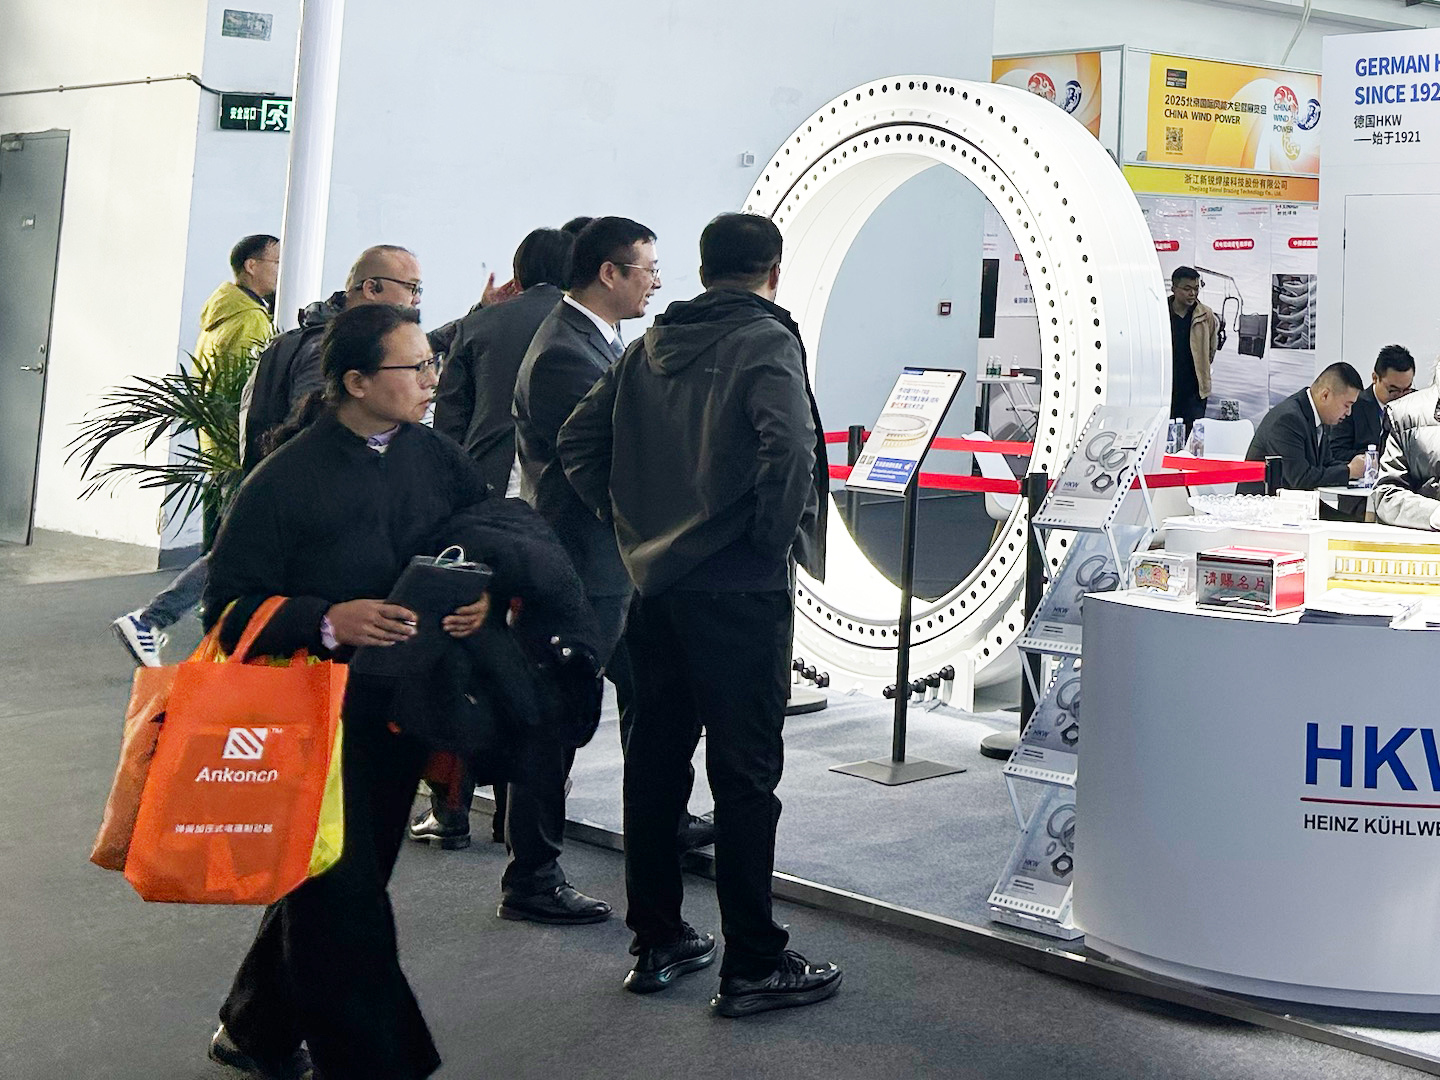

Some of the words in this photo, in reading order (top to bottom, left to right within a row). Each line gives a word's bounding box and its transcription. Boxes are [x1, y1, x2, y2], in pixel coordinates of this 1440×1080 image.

[1355, 54, 1430, 77] GERMAN
[1354, 84, 1406, 106] SINCE
[1164, 109, 1188, 120] CHINA
[1191, 111, 1212, 122] WIND
[1214, 114, 1241, 124] POWER
[1273, 104, 1291, 113] CHINA
[1354, 114, 1402, 129] 德国HKW
[1304, 813, 1359, 833] HEINZ
